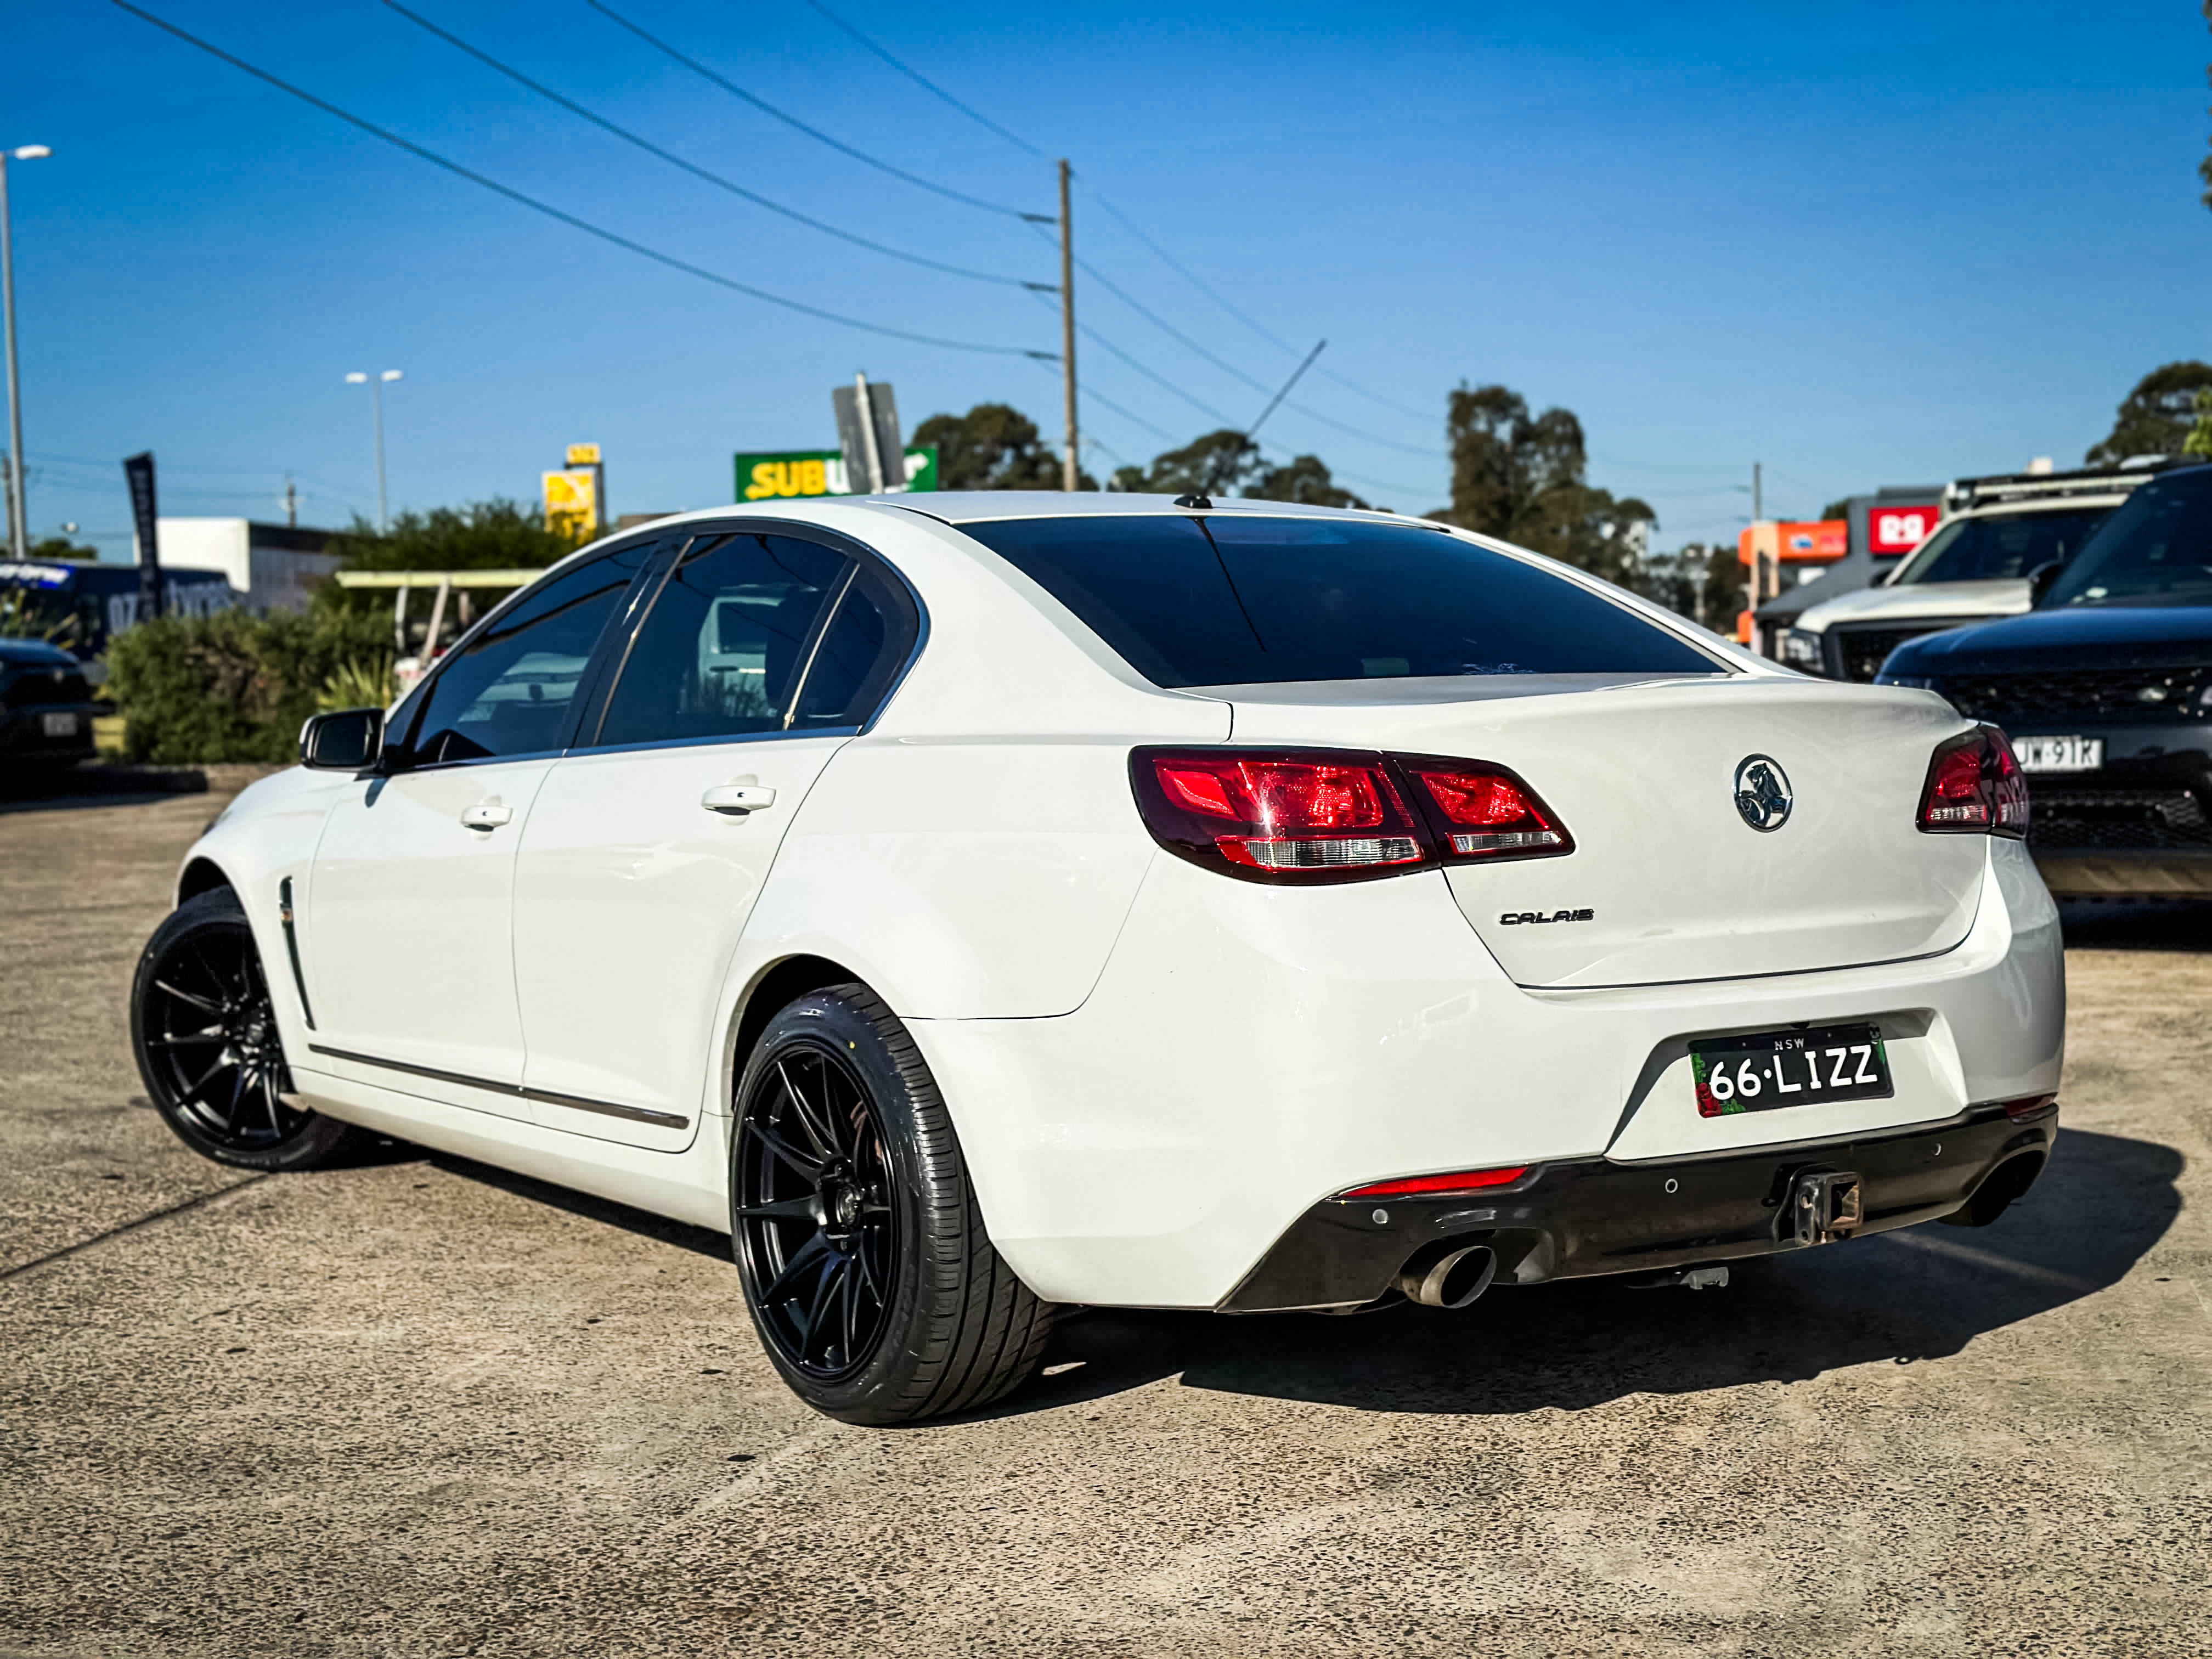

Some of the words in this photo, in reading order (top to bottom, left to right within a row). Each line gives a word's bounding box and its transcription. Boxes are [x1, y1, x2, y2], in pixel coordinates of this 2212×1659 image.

[744, 453, 929, 500] SUBWY
[1500, 909, 1594, 926] CALAIS
[1775, 1037, 1804, 1050] NSW
[1709, 1045, 1878, 1100] 66·LIZZ
